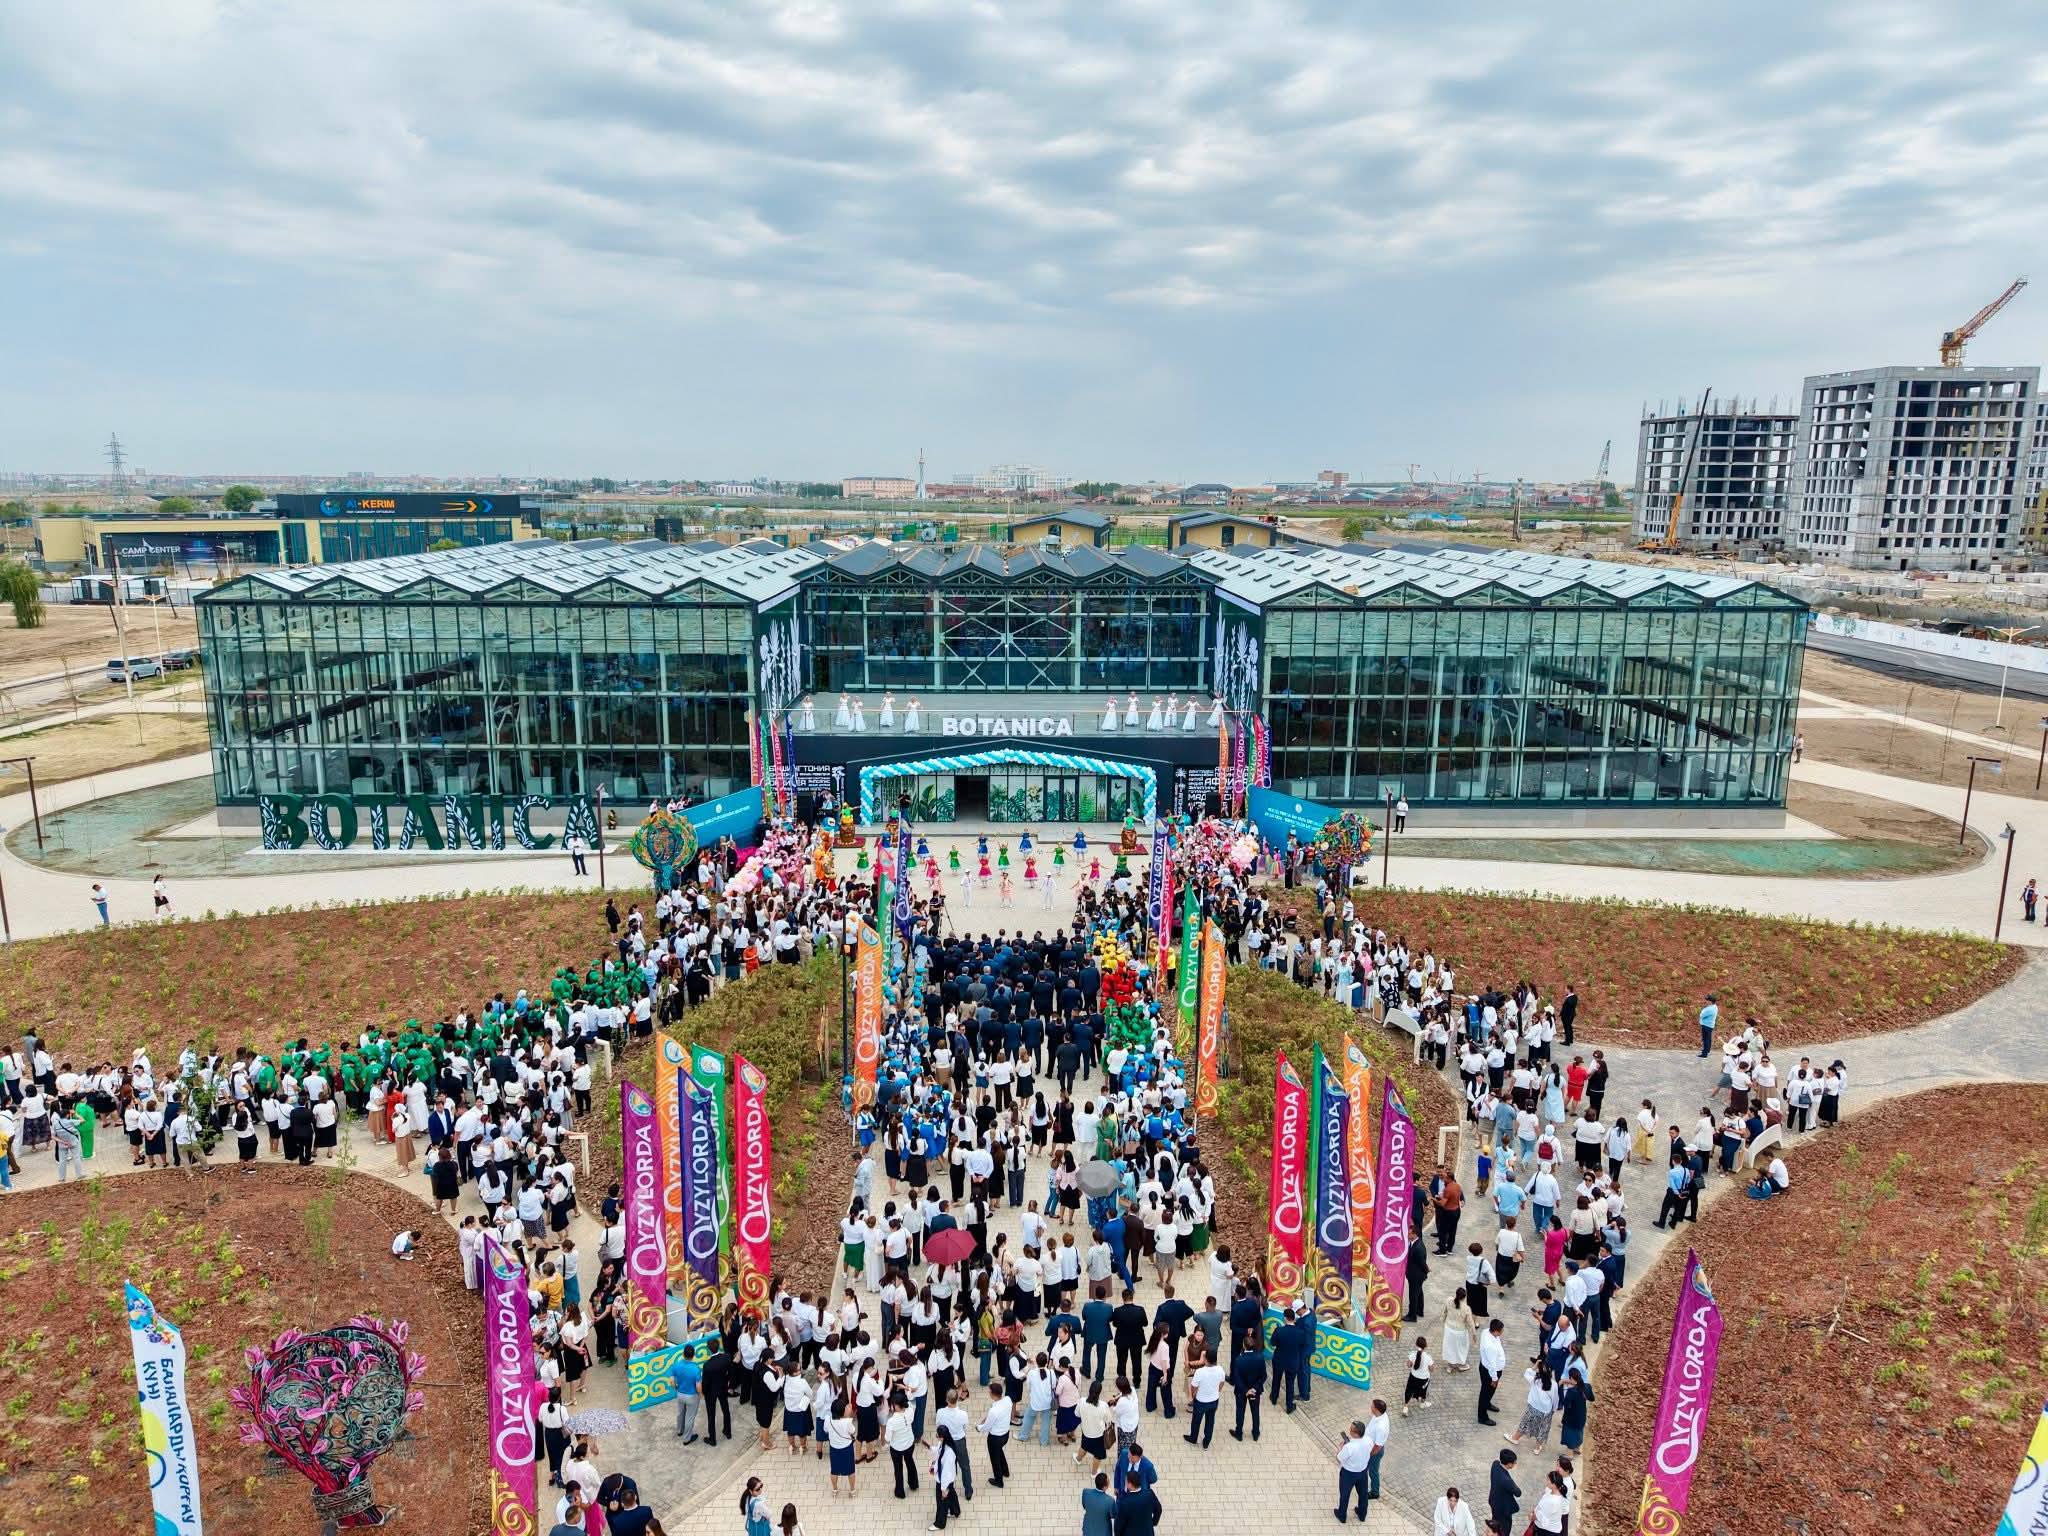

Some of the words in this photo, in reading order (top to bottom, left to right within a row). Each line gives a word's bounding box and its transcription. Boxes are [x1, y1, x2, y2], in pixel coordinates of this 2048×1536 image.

[121, 547, 147, 555] CAMP
[149, 545, 180, 554] CENTER
[942, 717, 1073, 736] BOTANICA
[259, 792, 605, 851] BOTANICA
[857, 951, 880, 1063] QYZYLORDA
[631, 1124, 667, 1276] QYZYLORDA
[688, 1109, 720, 1259] QYZYLORDA
[740, 1097, 771, 1243] QYZYLORDA
[1275, 1091, 1302, 1234] QYZYLORDA
[1321, 1102, 1353, 1247] QYZYLORDA
[1351, 1073, 1376, 1210] QYZYLORDA
[1376, 1120, 1409, 1265] QYZYLORDA
[496, 1289, 536, 1467] QYZYLORDA
[1656, 1306, 1711, 1475] QYZYLORDA
